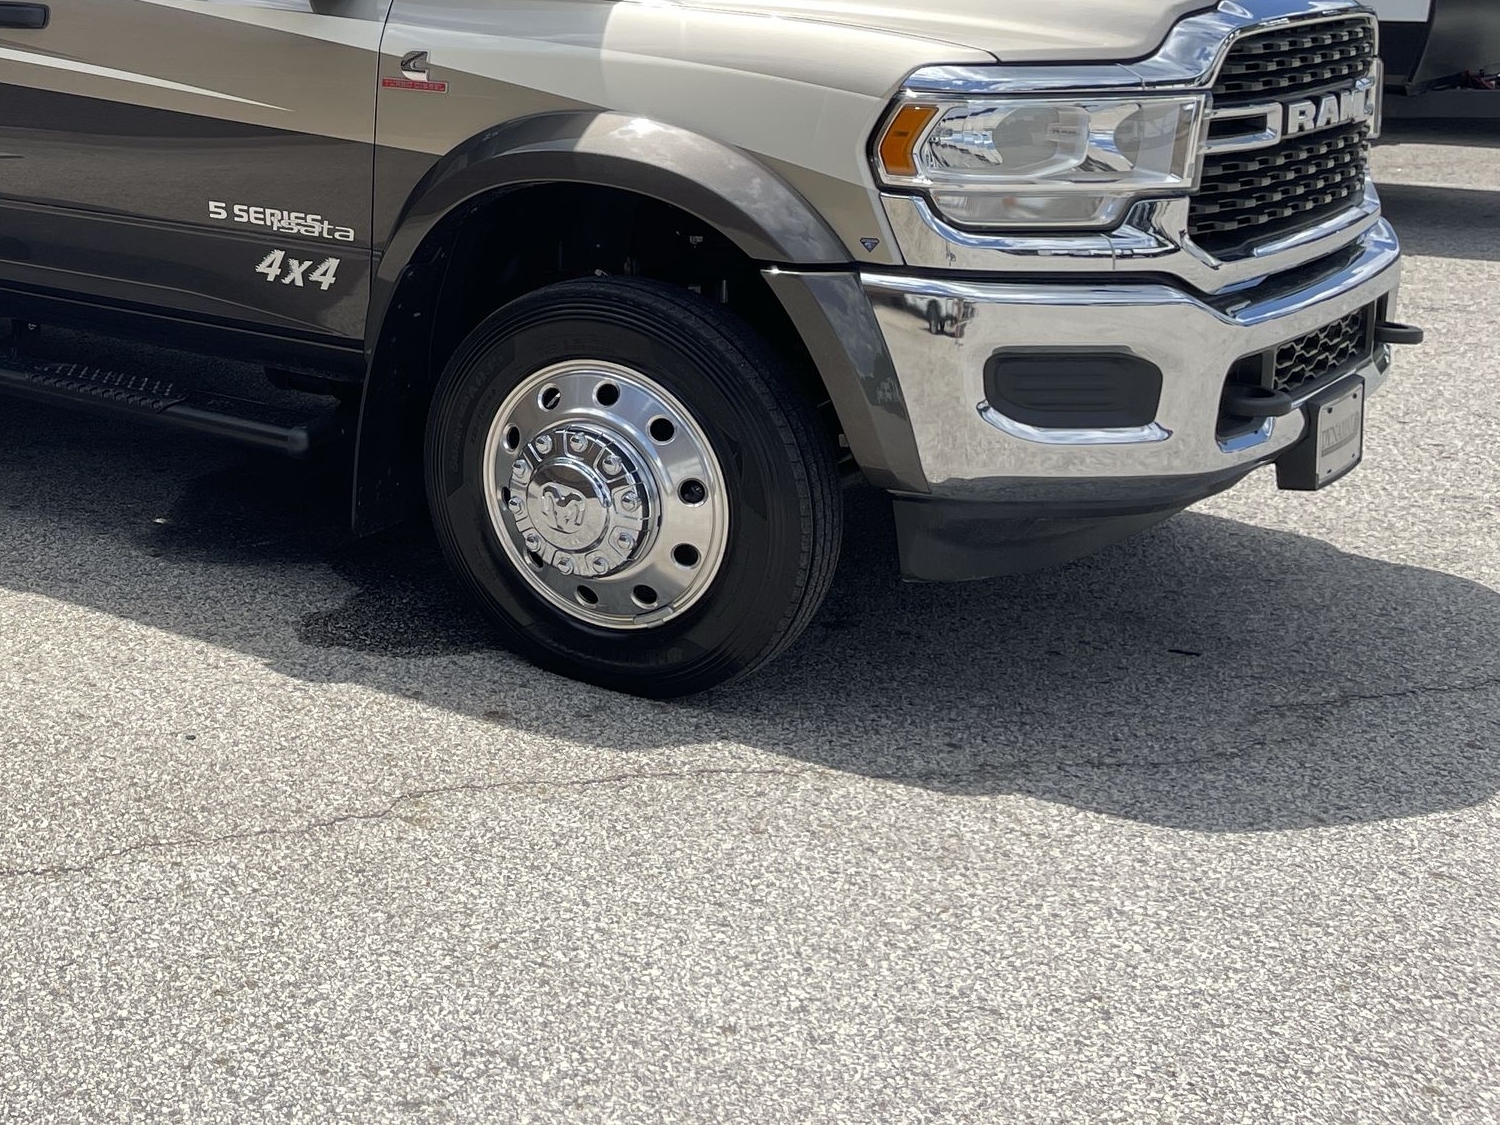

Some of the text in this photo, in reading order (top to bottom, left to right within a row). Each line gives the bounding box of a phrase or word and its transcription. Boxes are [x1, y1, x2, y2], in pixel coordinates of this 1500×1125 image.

[1287, 88, 1366, 134] RAM
[208, 200, 323, 232] 5 SERIES
